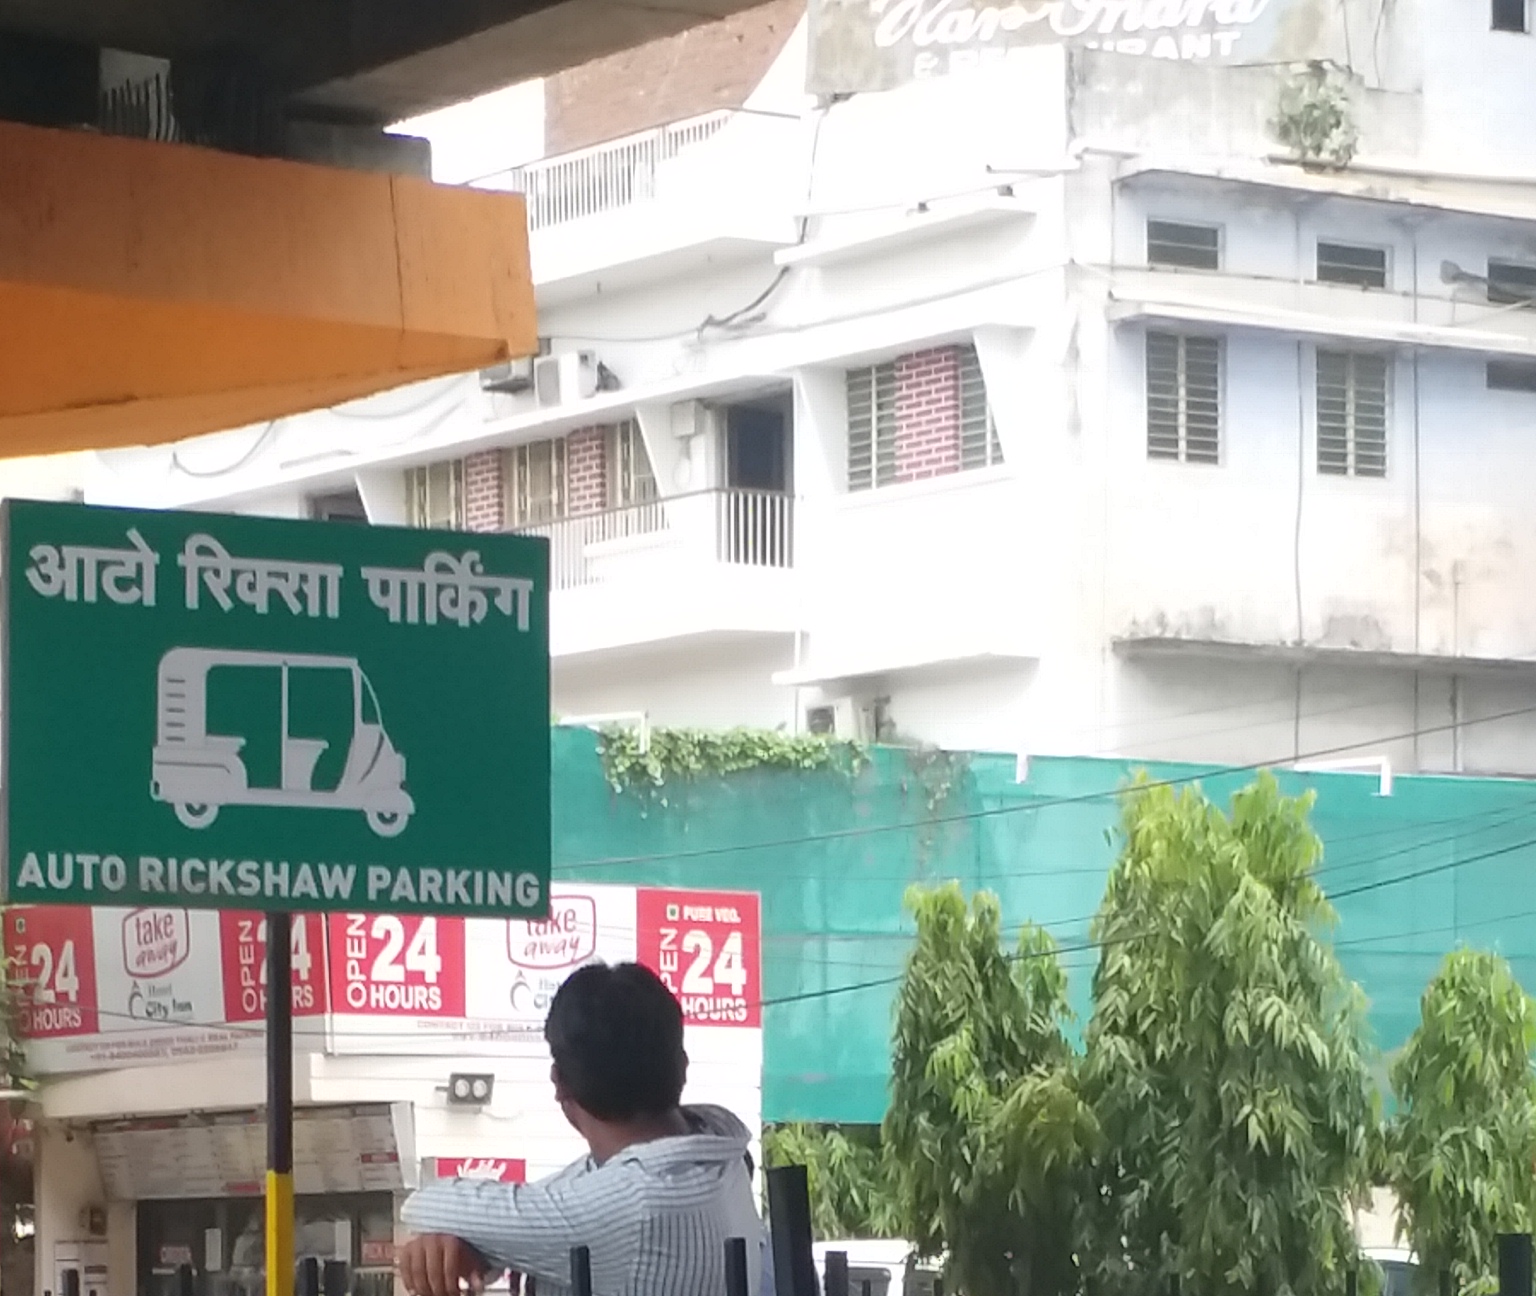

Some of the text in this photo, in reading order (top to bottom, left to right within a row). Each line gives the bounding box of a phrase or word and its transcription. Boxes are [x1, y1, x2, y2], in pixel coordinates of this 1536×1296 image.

[25, 528, 533, 632] आटो रिक्सा पार्किंग
[17, 852, 540, 908] AUTO RICKSHAW PARKING
[135, 910, 176, 945] take
[135, 938, 179, 969] away
[370, 914, 442, 983] 24
[523, 935, 581, 964] away
[11, 944, 33, 1031] OEN
[31, 938, 80, 1004] 24
[238, 920, 258, 1014] OPEN
[346, 913, 367, 1008] OPEN
[659, 928, 678, 993] PEN
[681, 929, 747, 995] 24
[33, 1008, 82, 1032] HOURS
[259, 986, 314, 1014] HRS
[369, 984, 443, 1010] HOURS
[680, 996, 747, 1022] HOURS
